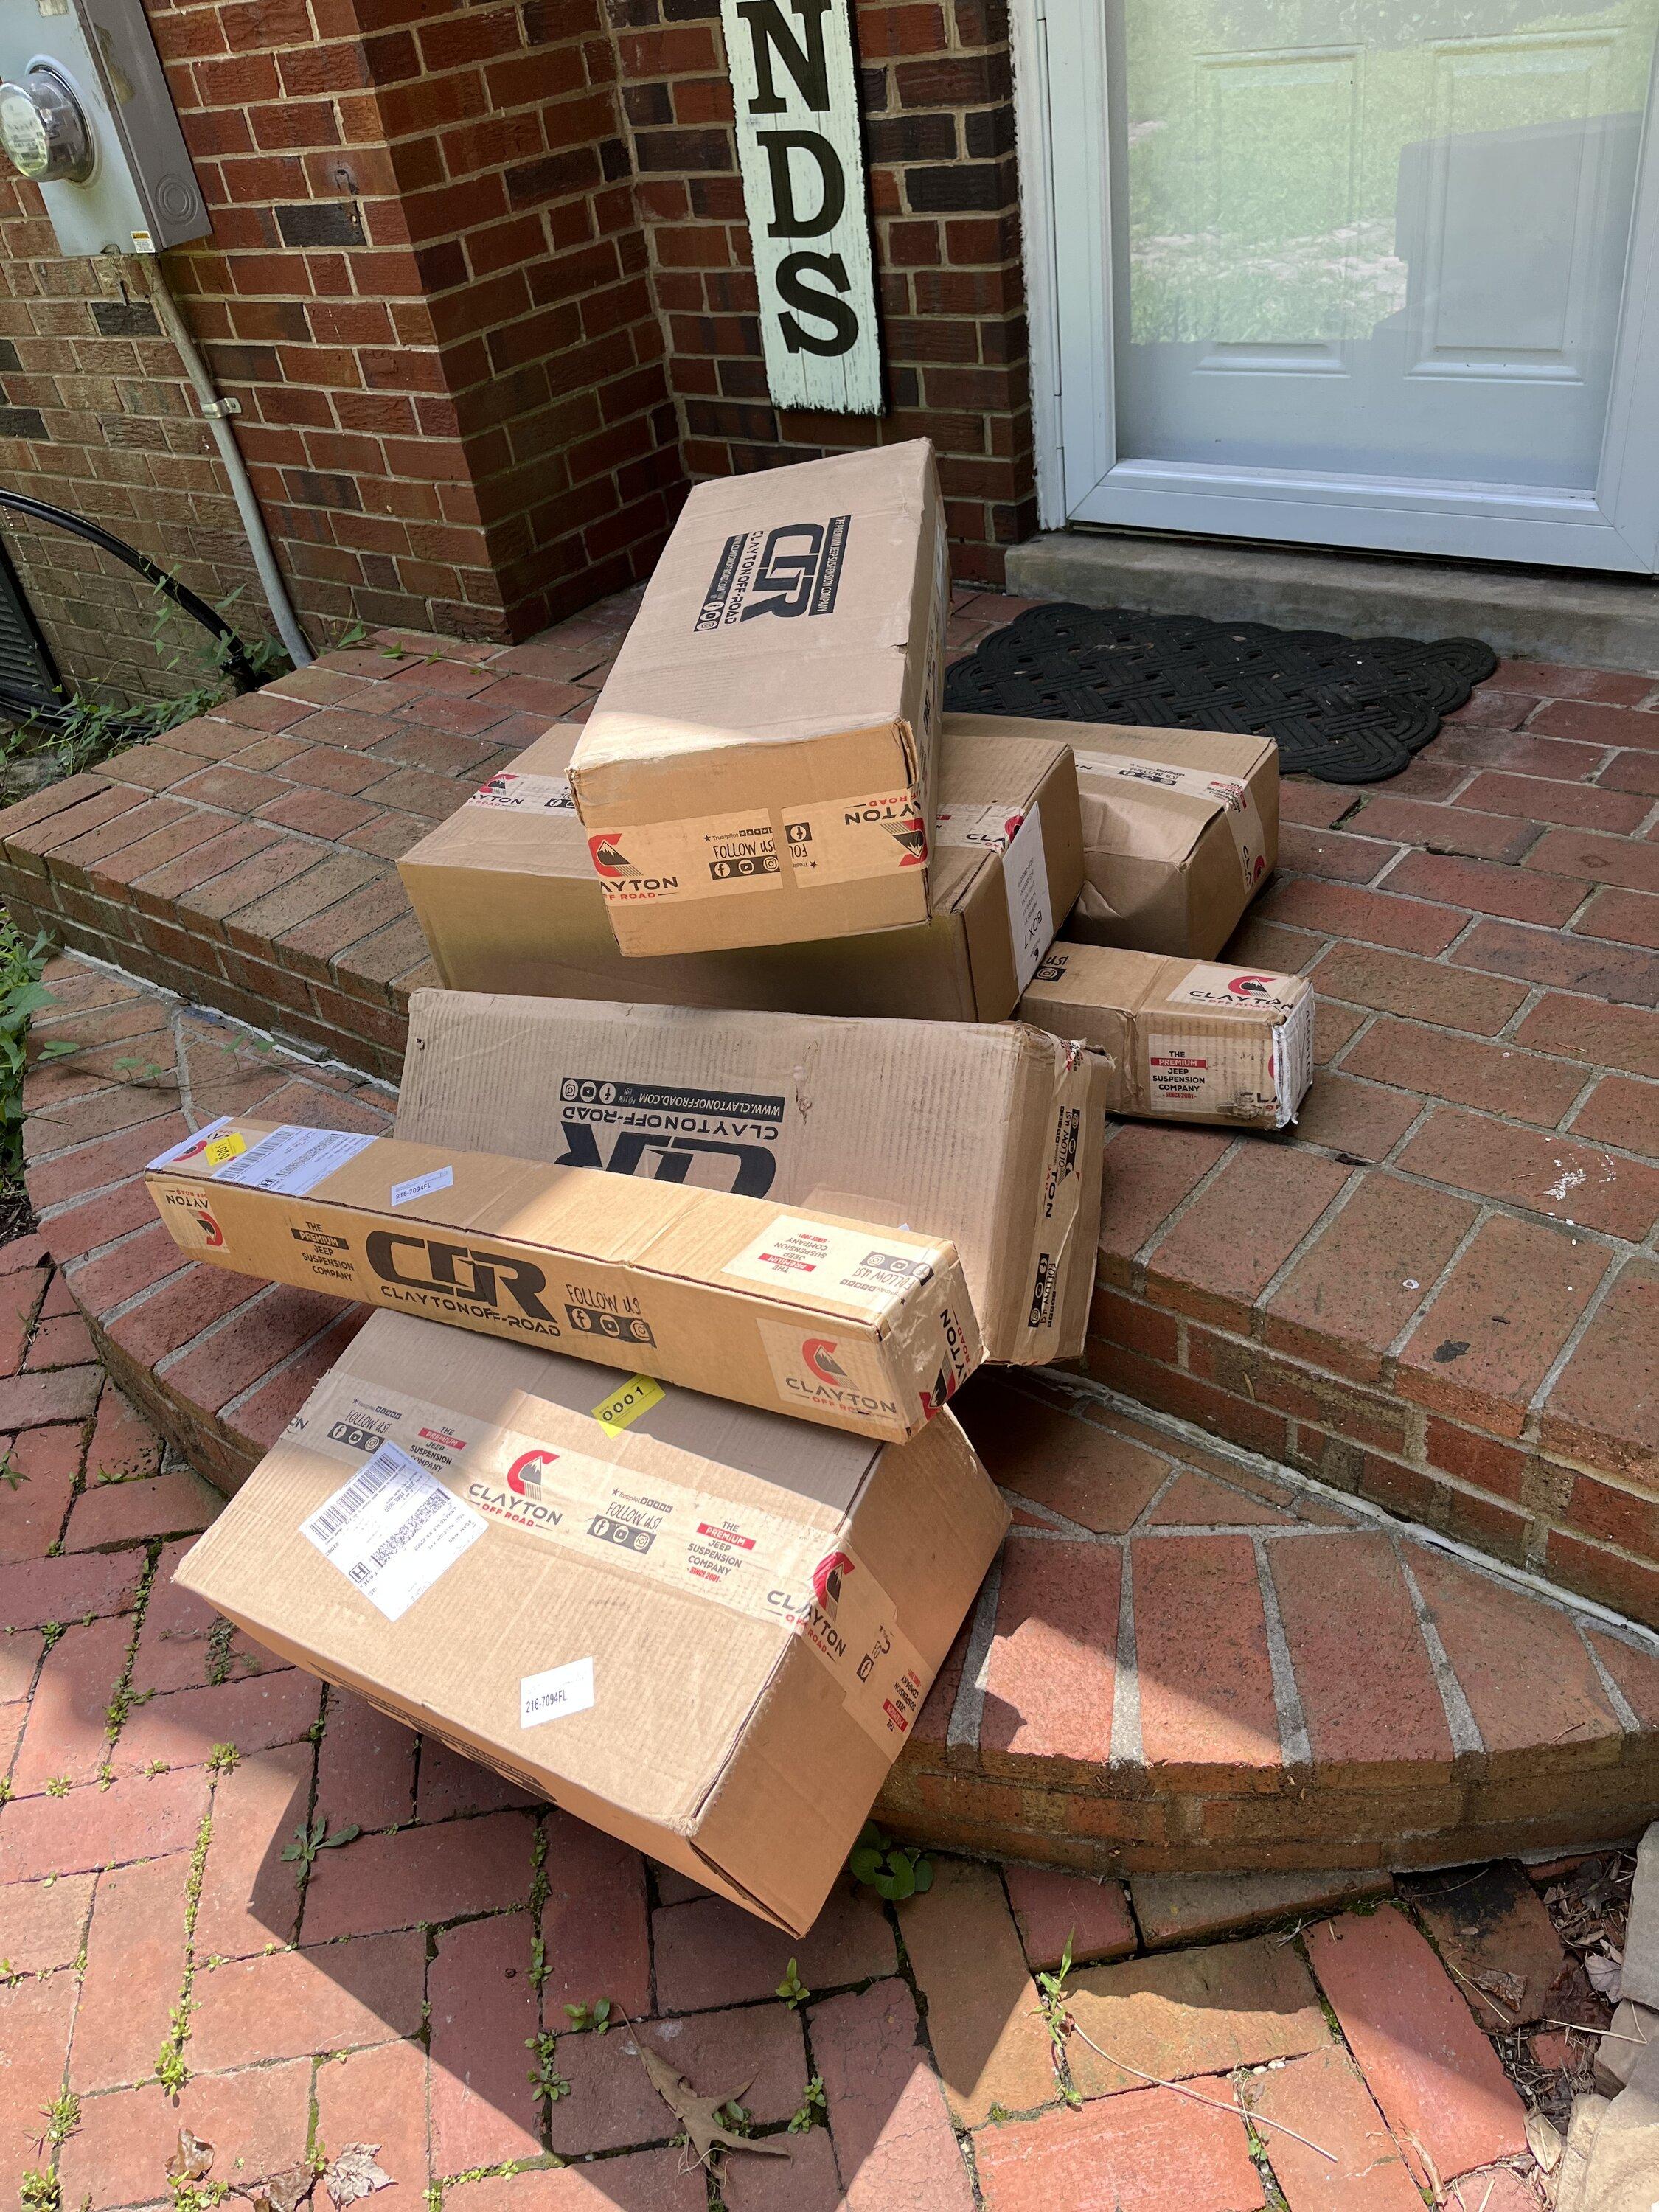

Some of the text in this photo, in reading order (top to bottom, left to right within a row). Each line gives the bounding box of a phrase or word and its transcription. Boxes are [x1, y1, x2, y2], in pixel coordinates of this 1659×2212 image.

[713, 841, 757, 859] FOLLOW
[1189, 991, 1294, 1009] CLAYTON
[1158, 1059, 1197, 1067] PREMIUM
[1152, 1075, 1205, 1083] SUSPENSION
[639, 1092, 781, 1116] WWW.CLAYTONOFFROAD.COM
[395, 1182, 431, 1200] 216-7094FL
[305, 1221, 323, 1232] THE
[299, 1231, 339, 1247] PREMIUM
[786, 1237, 828, 1251] COMPANY
[314, 1245, 333, 1256] JEEP
[774, 1242, 827, 1259] SUSPENSION
[783, 1252, 806, 1261] JEEP
[302, 1253, 355, 1271] SUSPENSION
[768, 1256, 807, 1270] PREMIUM
[772, 1265, 790, 1273] THE
[312, 1265, 352, 1281] COMPANY
[872, 1270, 916, 1290] FOLLOW
[566, 1284, 619, 1313] FOLLOW
[602, 1386, 644, 1421] 0001
[786, 1377, 897, 1414] CLAYTON
[345, 1410, 378, 1430] FOLLOW
[425, 1430, 459, 1447] PREMIUM
[440, 1426, 455, 1436] THE
[426, 1441, 445, 1450] JEEP
[410, 1444, 453, 1465] SUSPENSION
[468, 1482, 563, 1526] CLAYTON
[619, 1492, 640, 1503] Trustpilot
[482, 1503, 535, 1528] OFF ROAD
[605, 1502, 647, 1526] FOLLOW
[723, 1521, 740, 1532] THE
[706, 1527, 746, 1546] PREMIUM
[708, 1540, 731, 1552] JEEP
[687, 1543, 742, 1568] SUSPENSION
[351, 1565, 366, 1579] H
[688, 1555, 731, 1576] COMPANY
[689, 1566, 706, 1578] SINCE
[808, 1630, 827, 1654] ROAD
[526, 1690, 567, 1713] 216-7094FL
